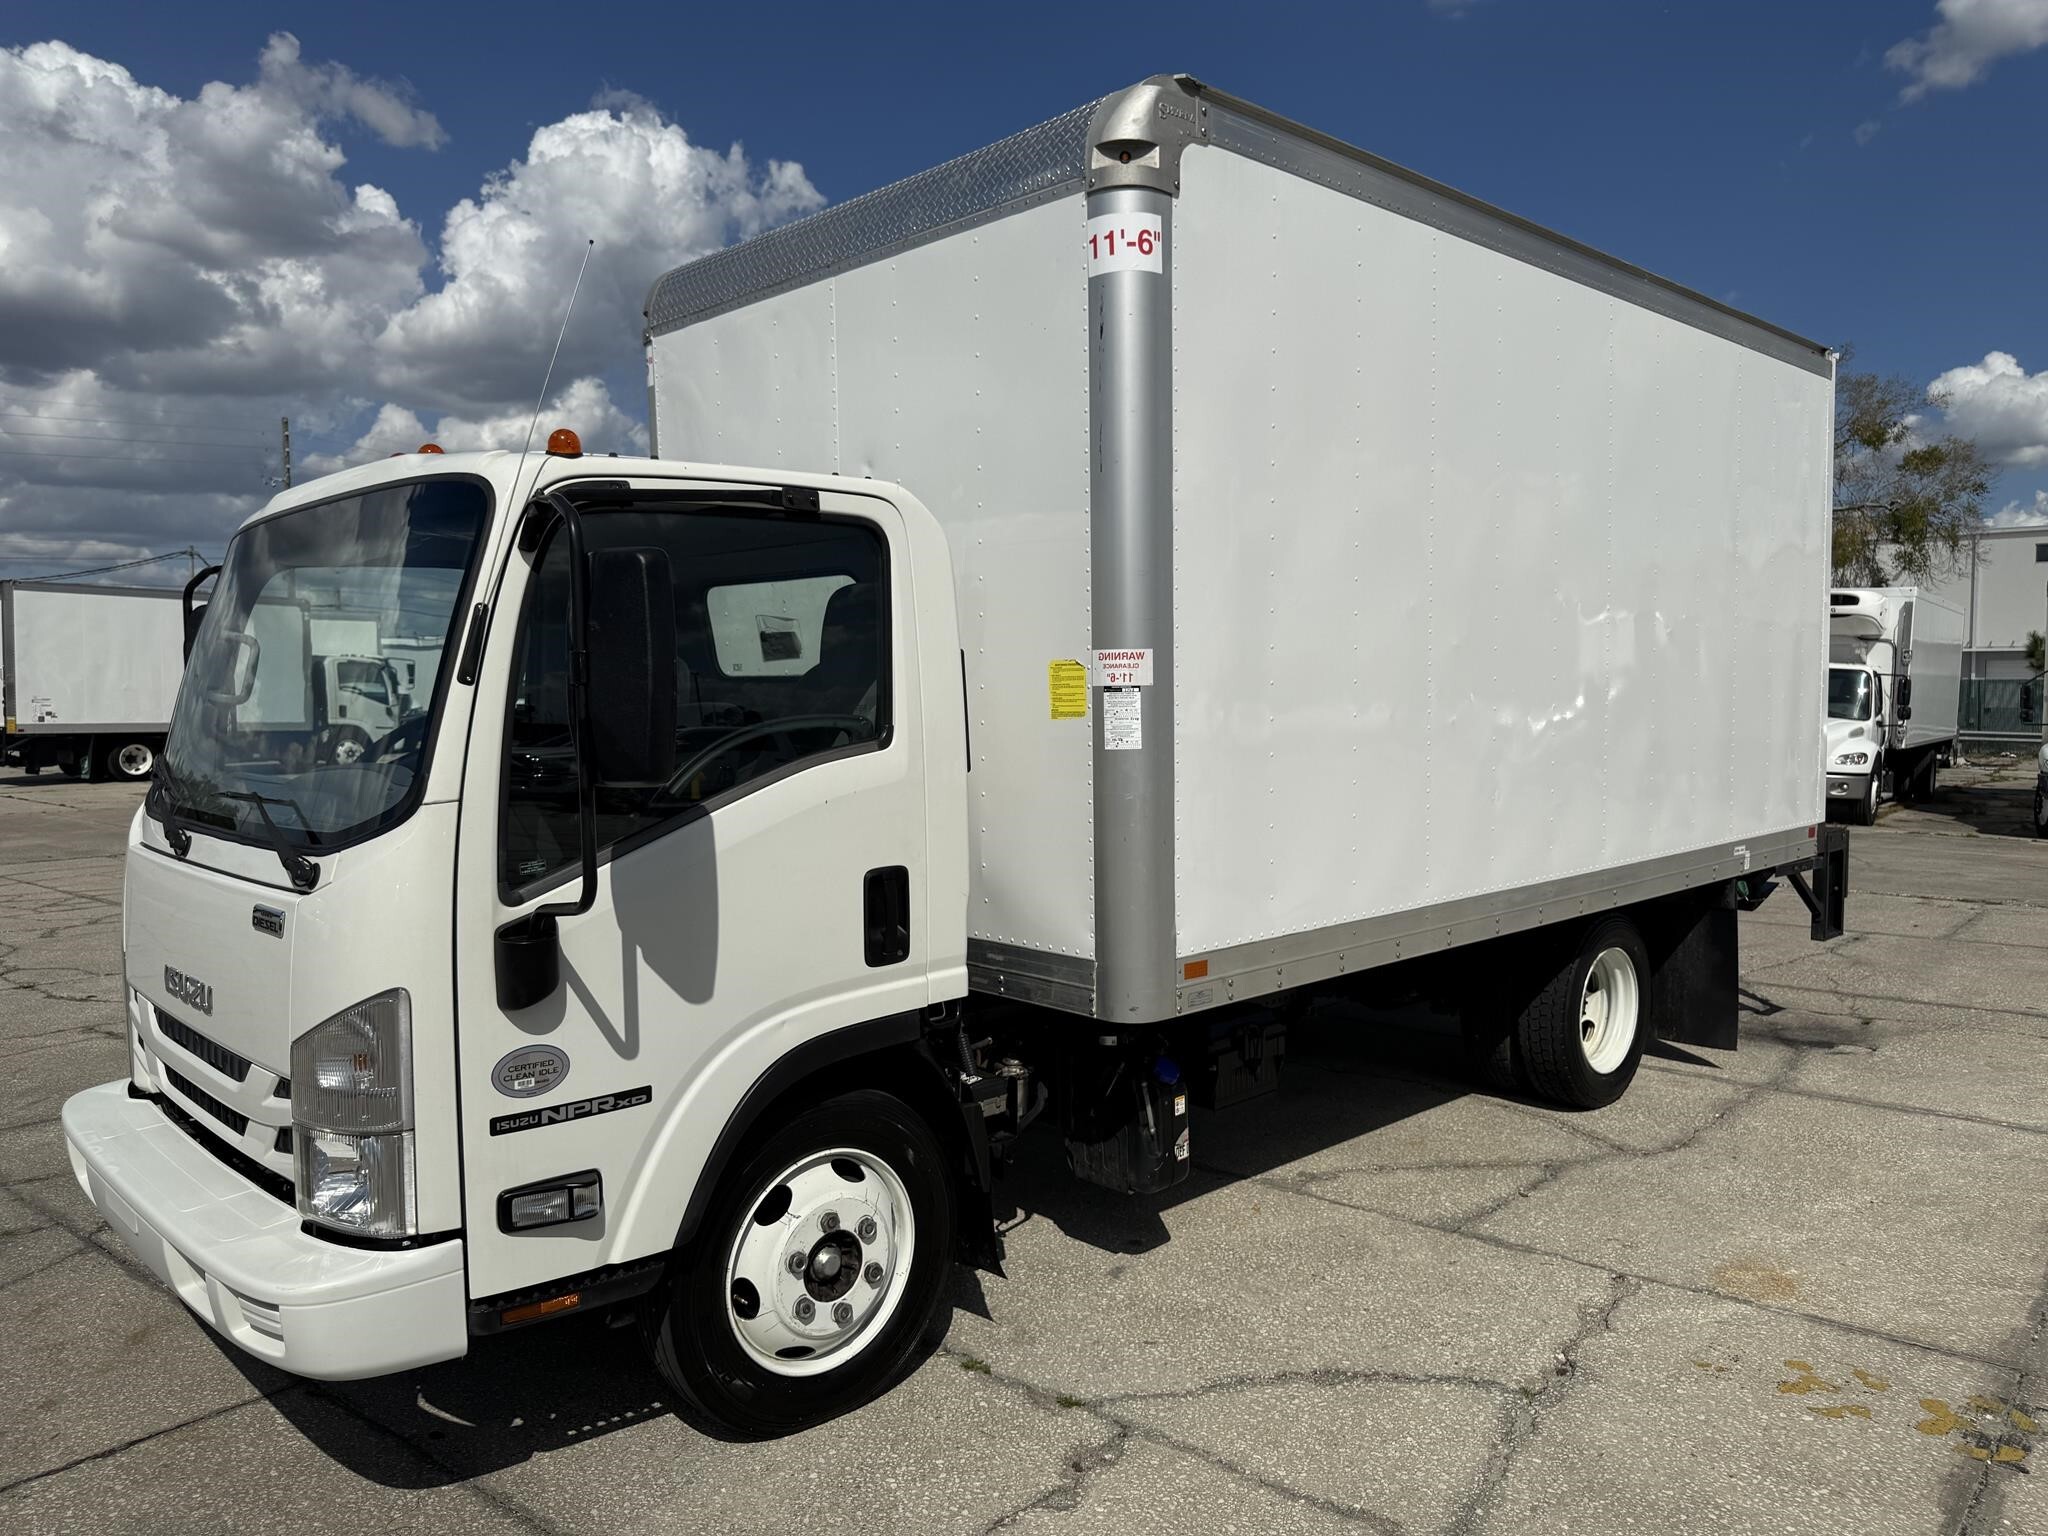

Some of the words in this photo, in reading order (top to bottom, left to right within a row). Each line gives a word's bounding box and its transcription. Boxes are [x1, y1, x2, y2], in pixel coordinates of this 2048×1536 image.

[1089, 229, 1161, 260] 11'-6"
[252, 915, 279, 933] DIESEL
[164, 964, 213, 1017] ISUZU
[503, 1070, 535, 1082] CLEAN
[538, 1066, 559, 1076] IDLE
[507, 1059, 555, 1073] CERTIFIED
[496, 1114, 539, 1131] ISUZU
